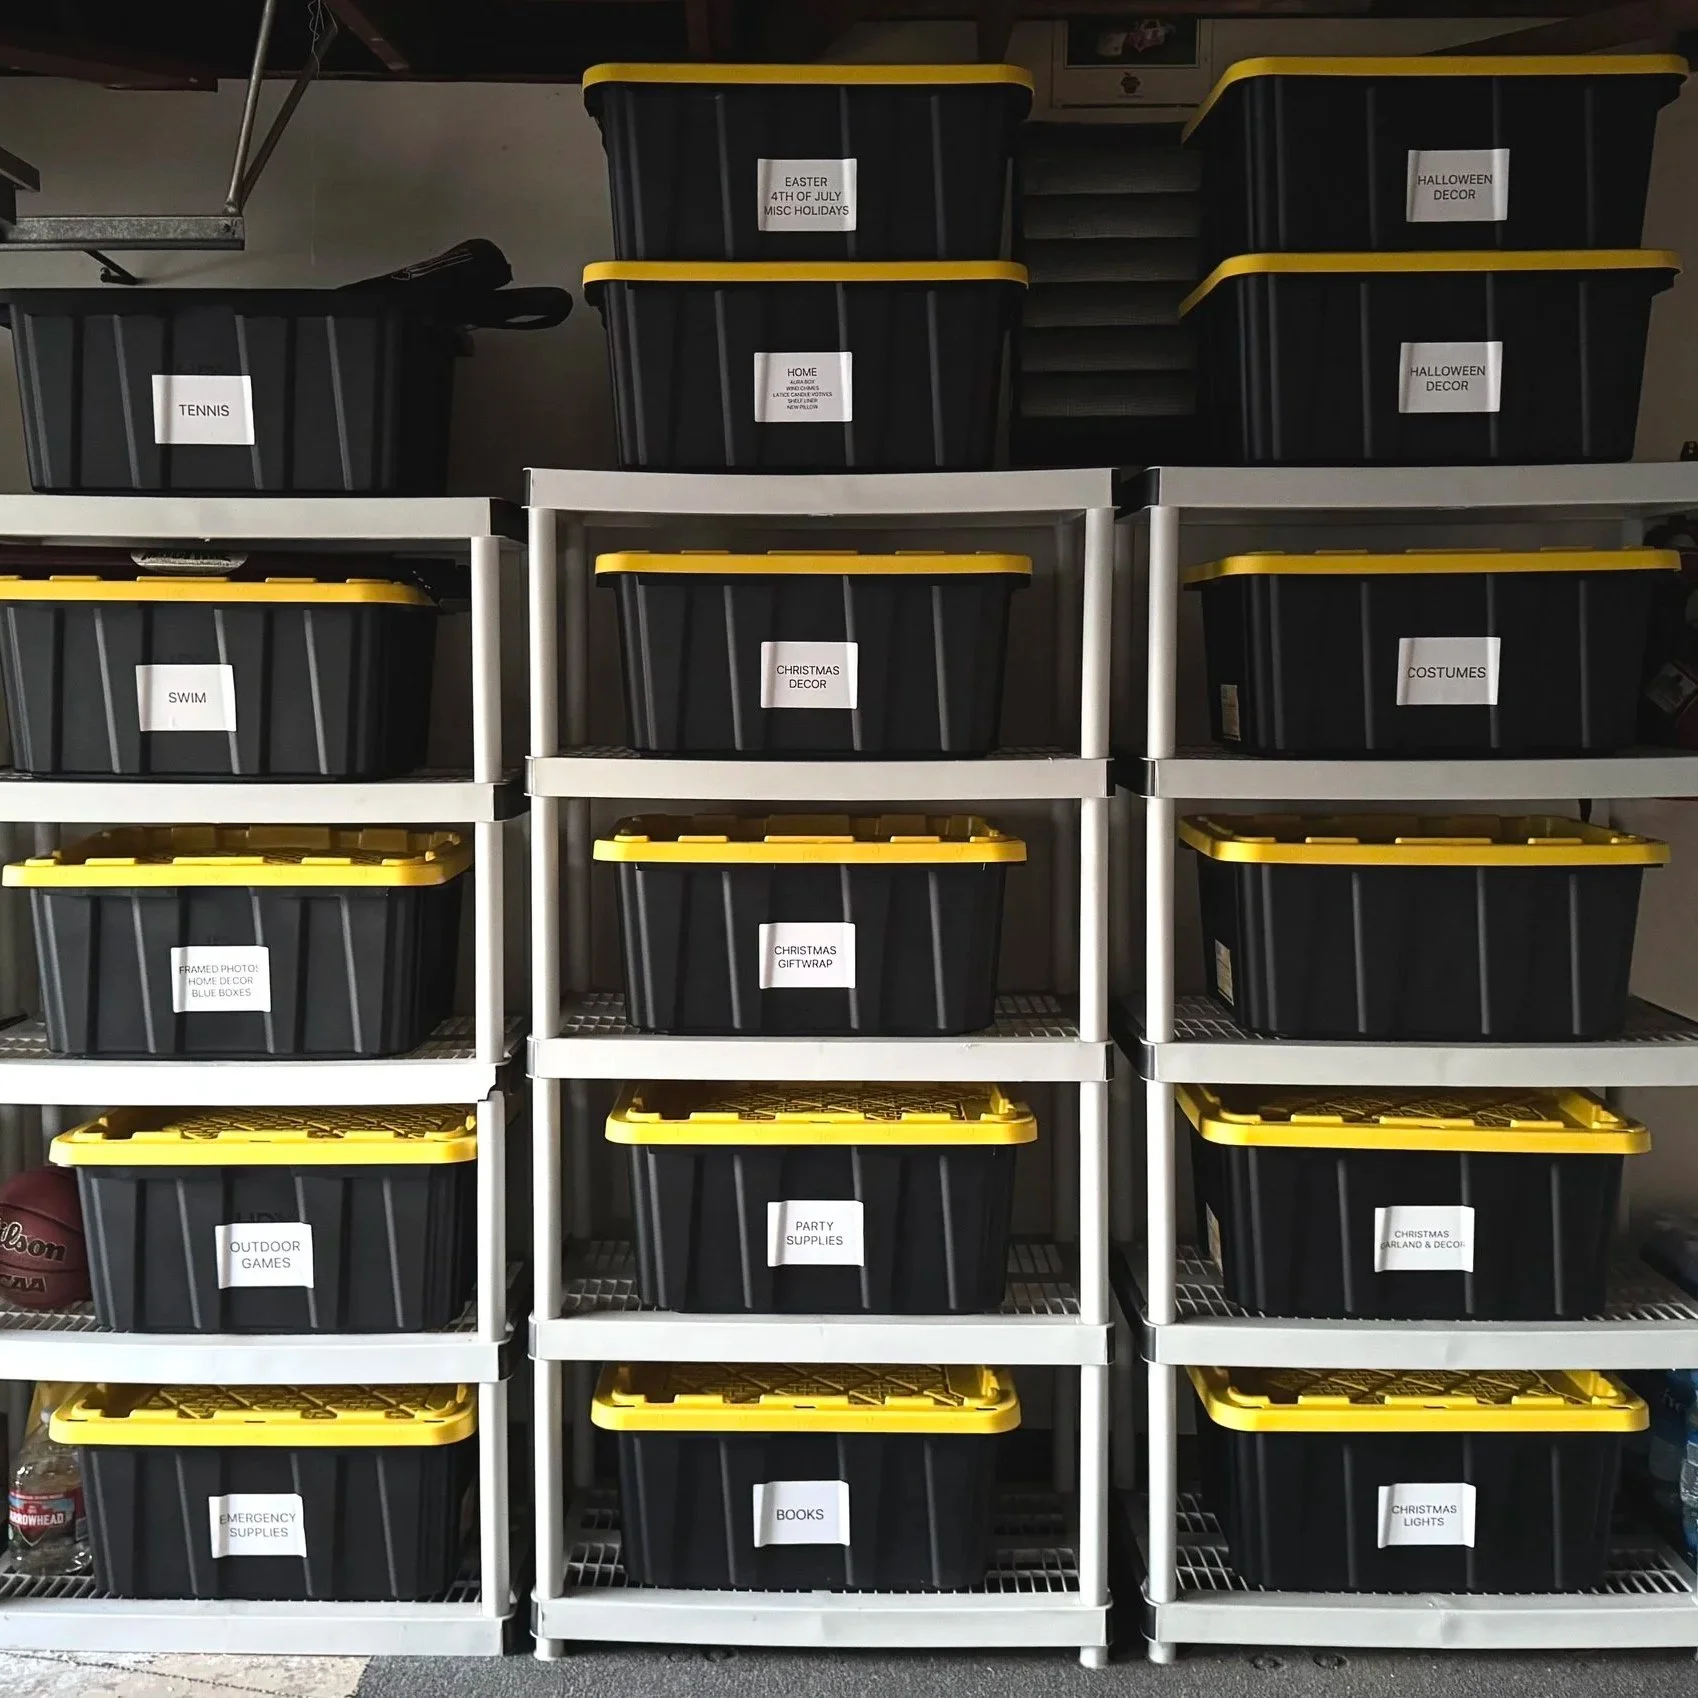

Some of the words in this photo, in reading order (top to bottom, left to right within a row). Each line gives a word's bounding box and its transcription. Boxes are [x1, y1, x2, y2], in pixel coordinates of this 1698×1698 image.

[785, 176, 828, 187] EASTER
[1417, 173, 1493, 186] HALLOWEEN
[771, 191, 794, 202] 4TH
[796, 191, 812, 202] OF
[814, 191, 841, 202] JULY
[1433, 188, 1476, 201] DECOR
[764, 205, 792, 217] MISC
[794, 205, 849, 216] HOLIDAYS
[787, 367, 817, 377] HOME
[1410, 365, 1486, 377] HALLOWEEN
[1426, 380, 1469, 392] DECOR
[178, 404, 230, 417] TENNIS
[776, 665, 840, 676] CHRISTMAS
[1407, 666, 1487, 679] COSTUMES
[789, 679, 827, 689] DECOR
[168, 692, 207, 704] SWIM
[774, 945, 837, 956] CHRISTMAS
[179, 965, 218, 974] FRAMED
[778, 958, 833, 969] GIFTWRAP
[188, 977, 217, 986] HOME
[219, 977, 253, 985] DECOR
[192, 989, 216, 997] BLUE
[219, 988, 251, 997] BOXES
[795, 1221, 833, 1232] PARTY
[0, 1217, 66, 1263] ilson
[1394, 1230, 1450, 1238] CHRISTMAS
[786, 1235, 843, 1246] SUPPLIES
[230, 1241, 301, 1253] OUTDOOR
[241, 1257, 291, 1269] GAMES
[776, 1508, 824, 1522] BOOKS
[1391, 1504, 1457, 1516] CHRISTMAS
[219, 1513, 296, 1526] EMERGENCY
[1404, 1517, 1445, 1528] LIGHTS
[229, 1527, 289, 1539] SUPPLIES
